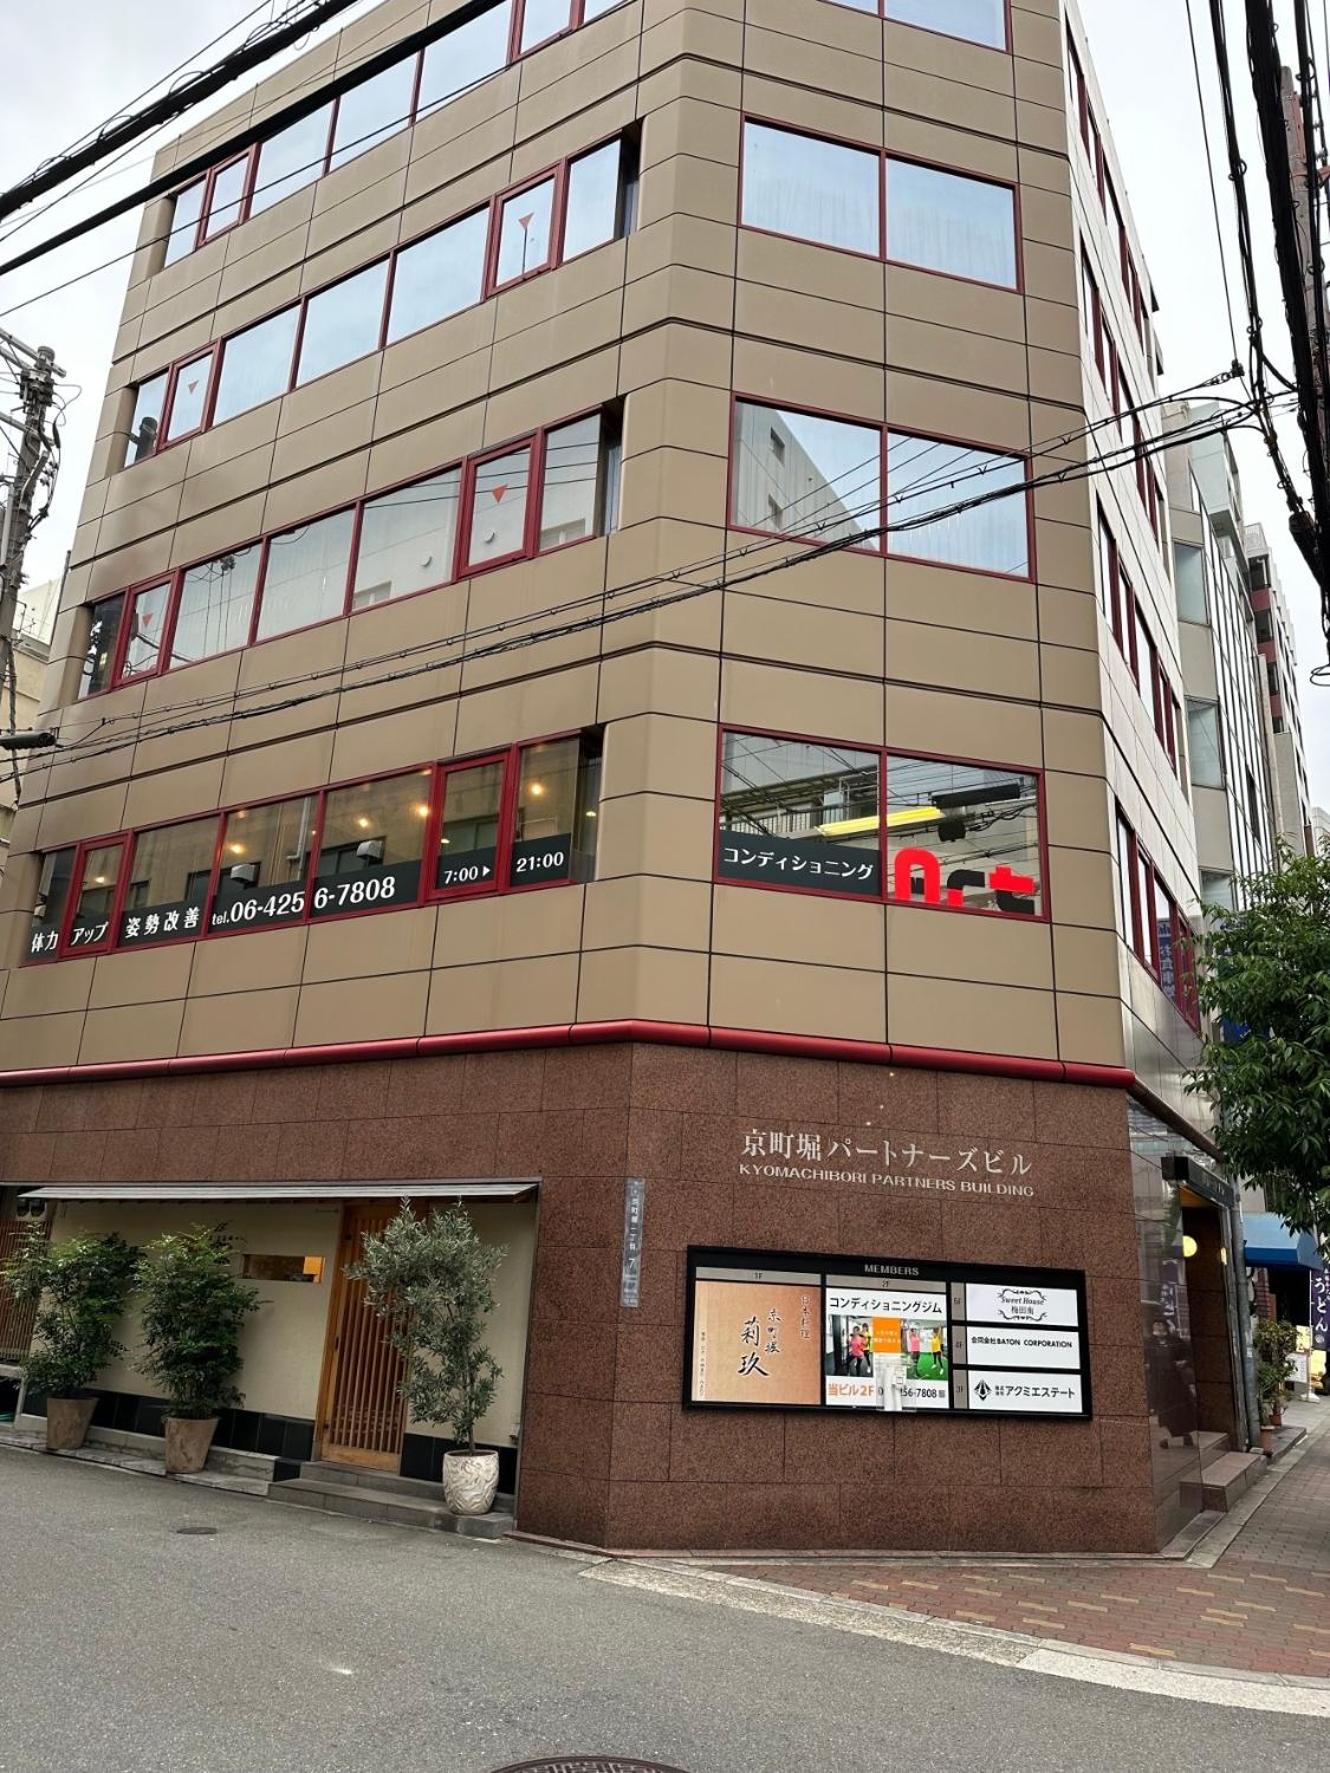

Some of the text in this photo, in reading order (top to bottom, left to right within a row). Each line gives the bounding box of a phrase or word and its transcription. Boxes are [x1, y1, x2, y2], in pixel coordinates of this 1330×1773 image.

[444, 851, 564, 885] 7:00 21:00
[724, 847, 873, 880] コンディショニング
[125, 906, 200, 938] 姿勢改善
[741, 1128, 1032, 1175] 京町堀パートナーズビル
[739, 1163, 1035, 1197] KYOMACHIBORI PARTNERS BUILDING
[864, 1263, 920, 1277] MEMBERS
[830, 1296, 943, 1314] コンディショニングジム
[1001, 1296, 1045, 1306] Sweet House
[1314, 1277, 1328, 1332] うどん
[1023, 1338, 1072, 1348] CORPORATION
[828, 1383, 875, 1398] 当ビル2F
[1005, 1385, 1076, 1399] アクミエステート
